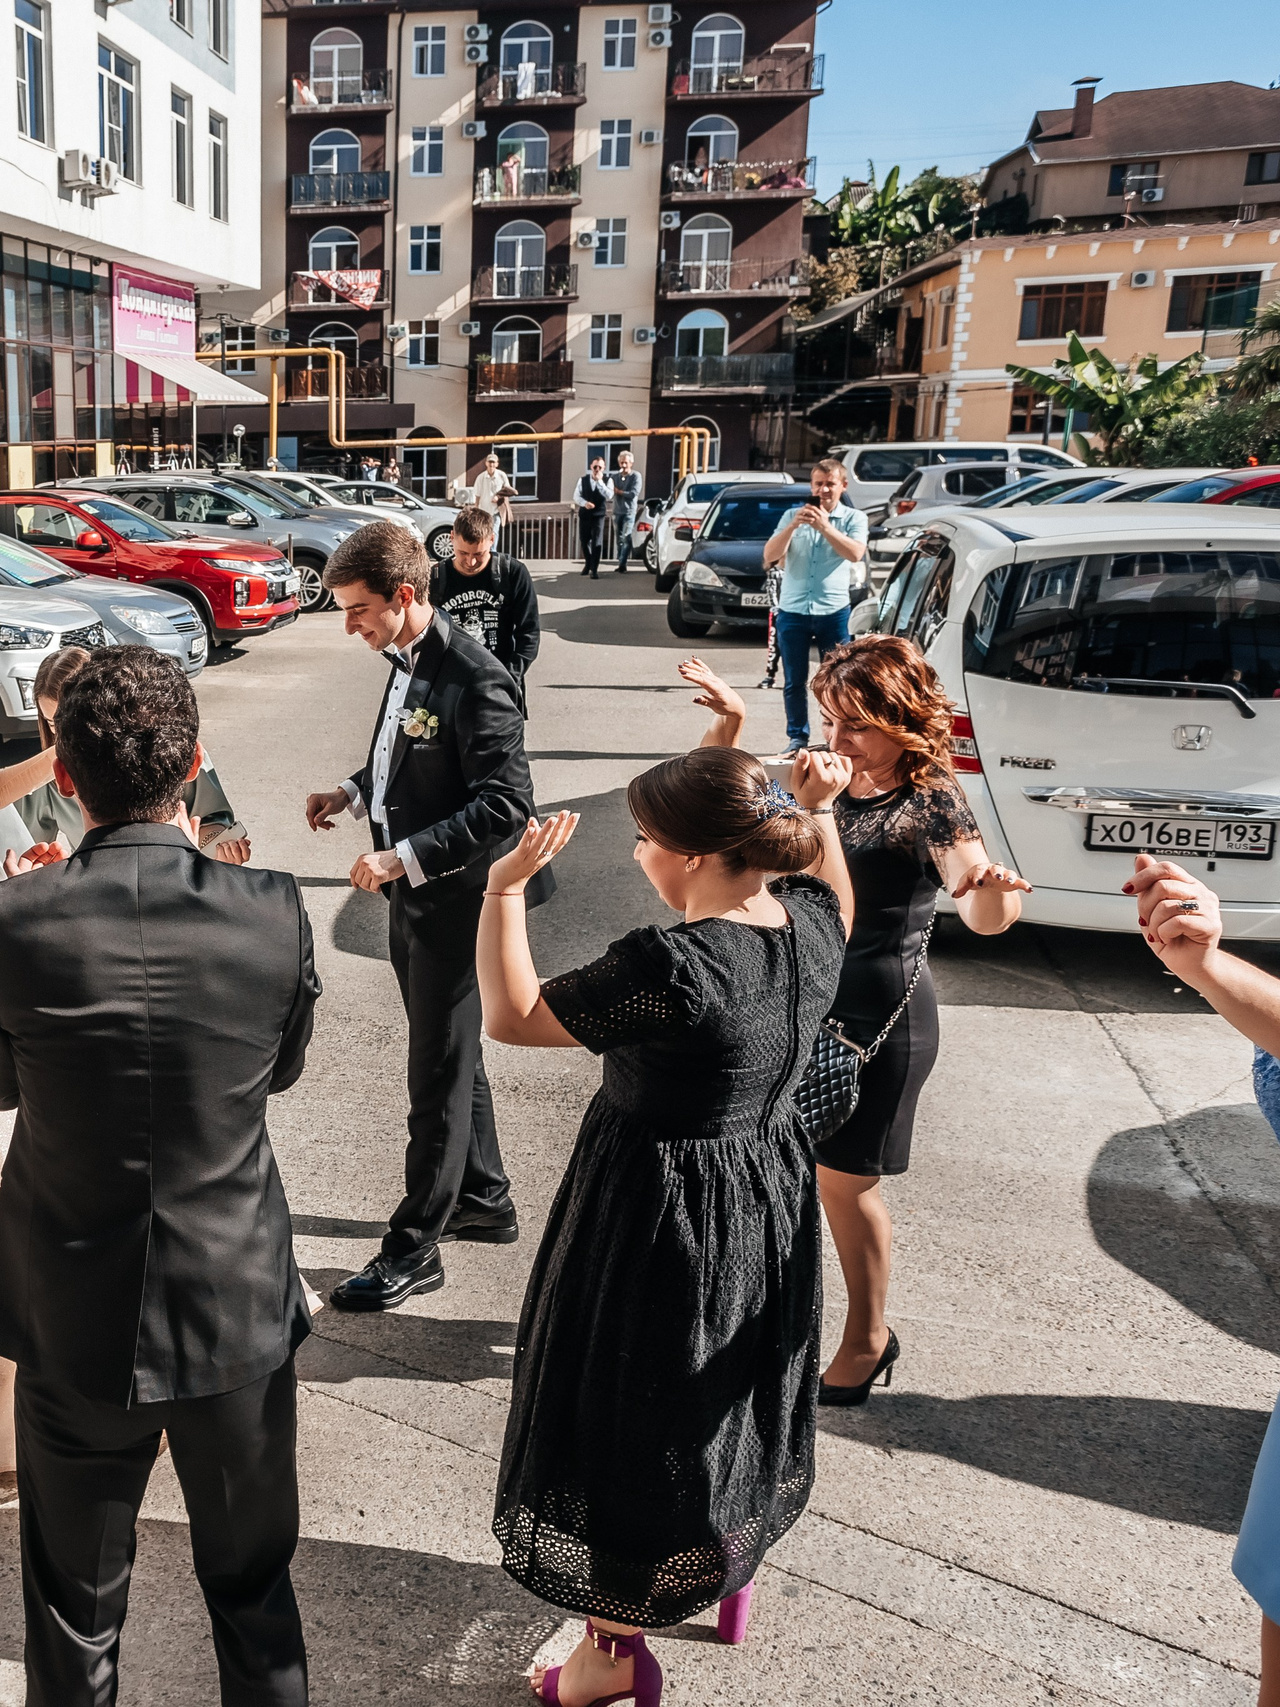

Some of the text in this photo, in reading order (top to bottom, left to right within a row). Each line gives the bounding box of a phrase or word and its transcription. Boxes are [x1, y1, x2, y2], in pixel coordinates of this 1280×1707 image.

[1000, 755, 1056, 770] FREED
[1219, 823, 1263, 844] 193
[1227, 842, 1249, 850] RUS
